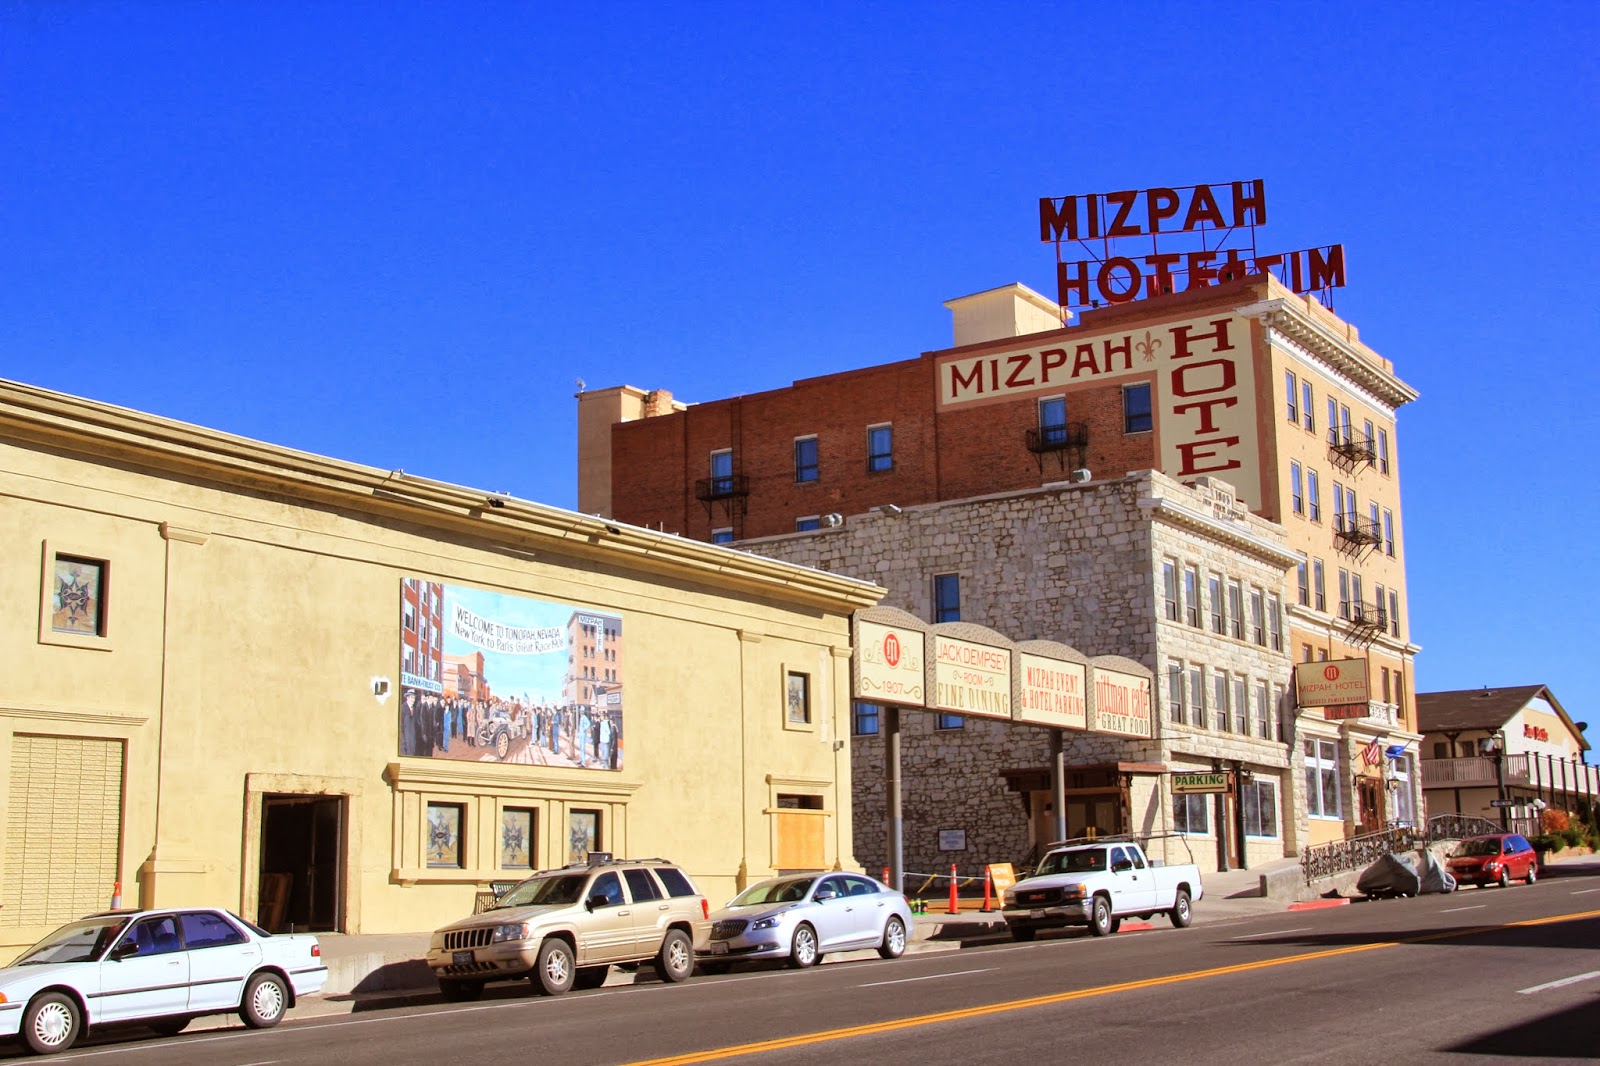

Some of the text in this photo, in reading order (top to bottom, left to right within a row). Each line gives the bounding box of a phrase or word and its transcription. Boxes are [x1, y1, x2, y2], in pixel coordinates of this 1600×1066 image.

[1039, 179, 1266, 243] MIZPAH
[950, 336, 1132, 398] MIZPAH
[1168, 318, 1241, 478] HOTE
[455, 621, 470, 639] New
[469, 629, 485, 647] York
[487, 638, 495, 649] to
[497, 639, 514, 653] Paris
[516, 641, 533, 653] Great
[535, 641, 551, 653] Race
[456, 606, 494, 636] WELCOME
[496, 625, 504, 639] TO
[537, 628, 560, 640] NEVADA
[937, 642, 1008, 671] JACK DEMPSEY
[882, 681, 904, 694] 1907
[963, 672, 983, 686] ROOM
[1027, 666, 1078, 694] MIZPAH EVENT
[1299, 681, 1366, 693] MIZPAH HOTEL
[937, 682, 1009, 714] FINE DINING
[1030, 689, 1053, 712] HOTEL
[1055, 693, 1084, 716] PARKING
[1096, 674, 1129, 719] pittman
[1101, 713, 1149, 735] GREAT FOOD
[1175, 774, 1224, 786] PARKING
